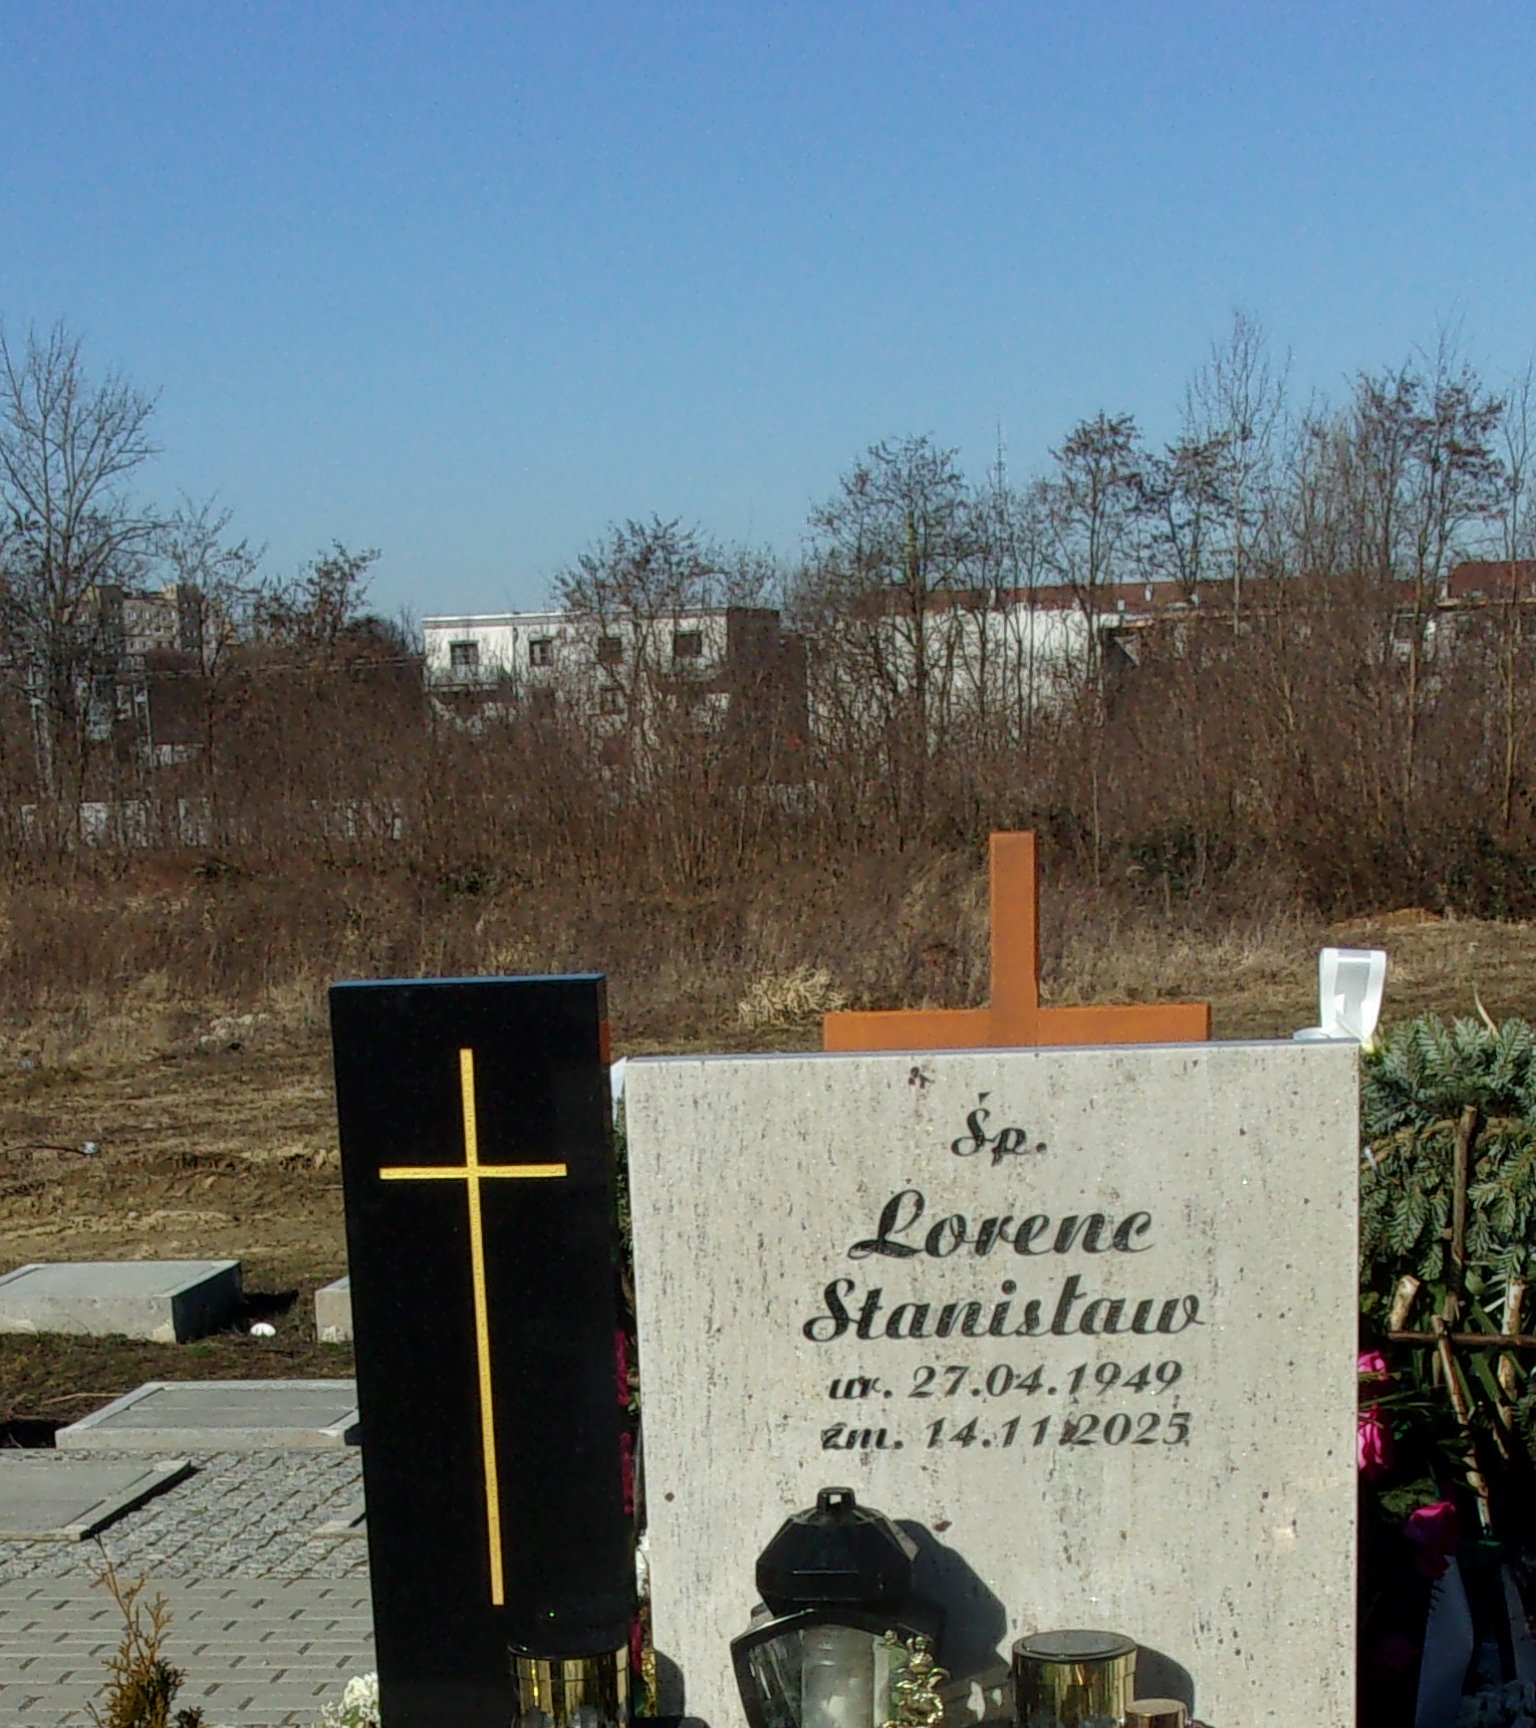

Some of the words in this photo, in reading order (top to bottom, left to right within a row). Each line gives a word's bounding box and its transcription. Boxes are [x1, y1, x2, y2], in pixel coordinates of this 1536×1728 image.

[950, 1091, 1048, 1167] Śp.
[846, 1188, 1156, 1260] Lorenc
[801, 1273, 1206, 1343] Stanisław
[828, 1375, 894, 1400] ur.
[908, 1358, 1184, 1400] 27.04.1949
[820, 1421, 904, 1451] zm.
[925, 1410, 1193, 1450] 14.11.2025
